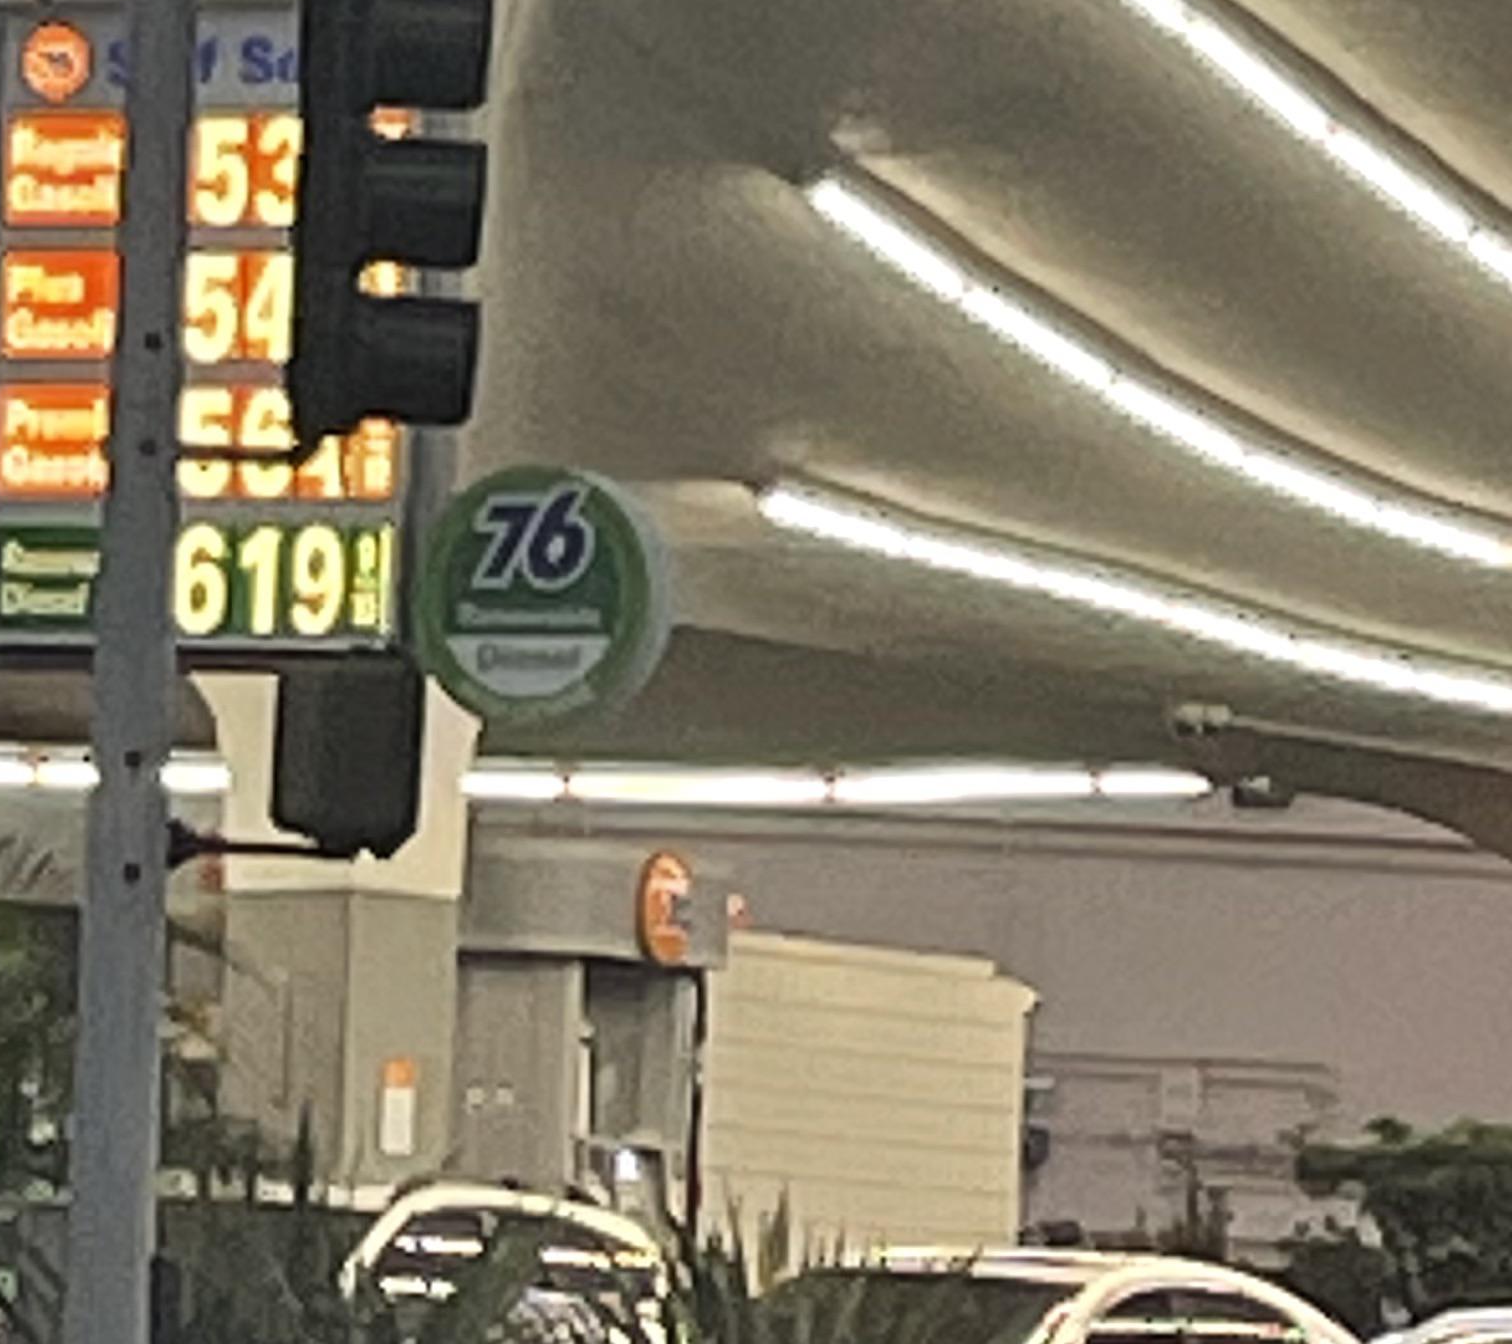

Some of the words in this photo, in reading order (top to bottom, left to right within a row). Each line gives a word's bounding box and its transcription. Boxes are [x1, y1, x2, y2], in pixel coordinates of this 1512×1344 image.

[194, 117, 303, 227] 53
[184, 254, 294, 364] 54
[175, 522, 345, 635] 619
[473, 481, 596, 593] 76
